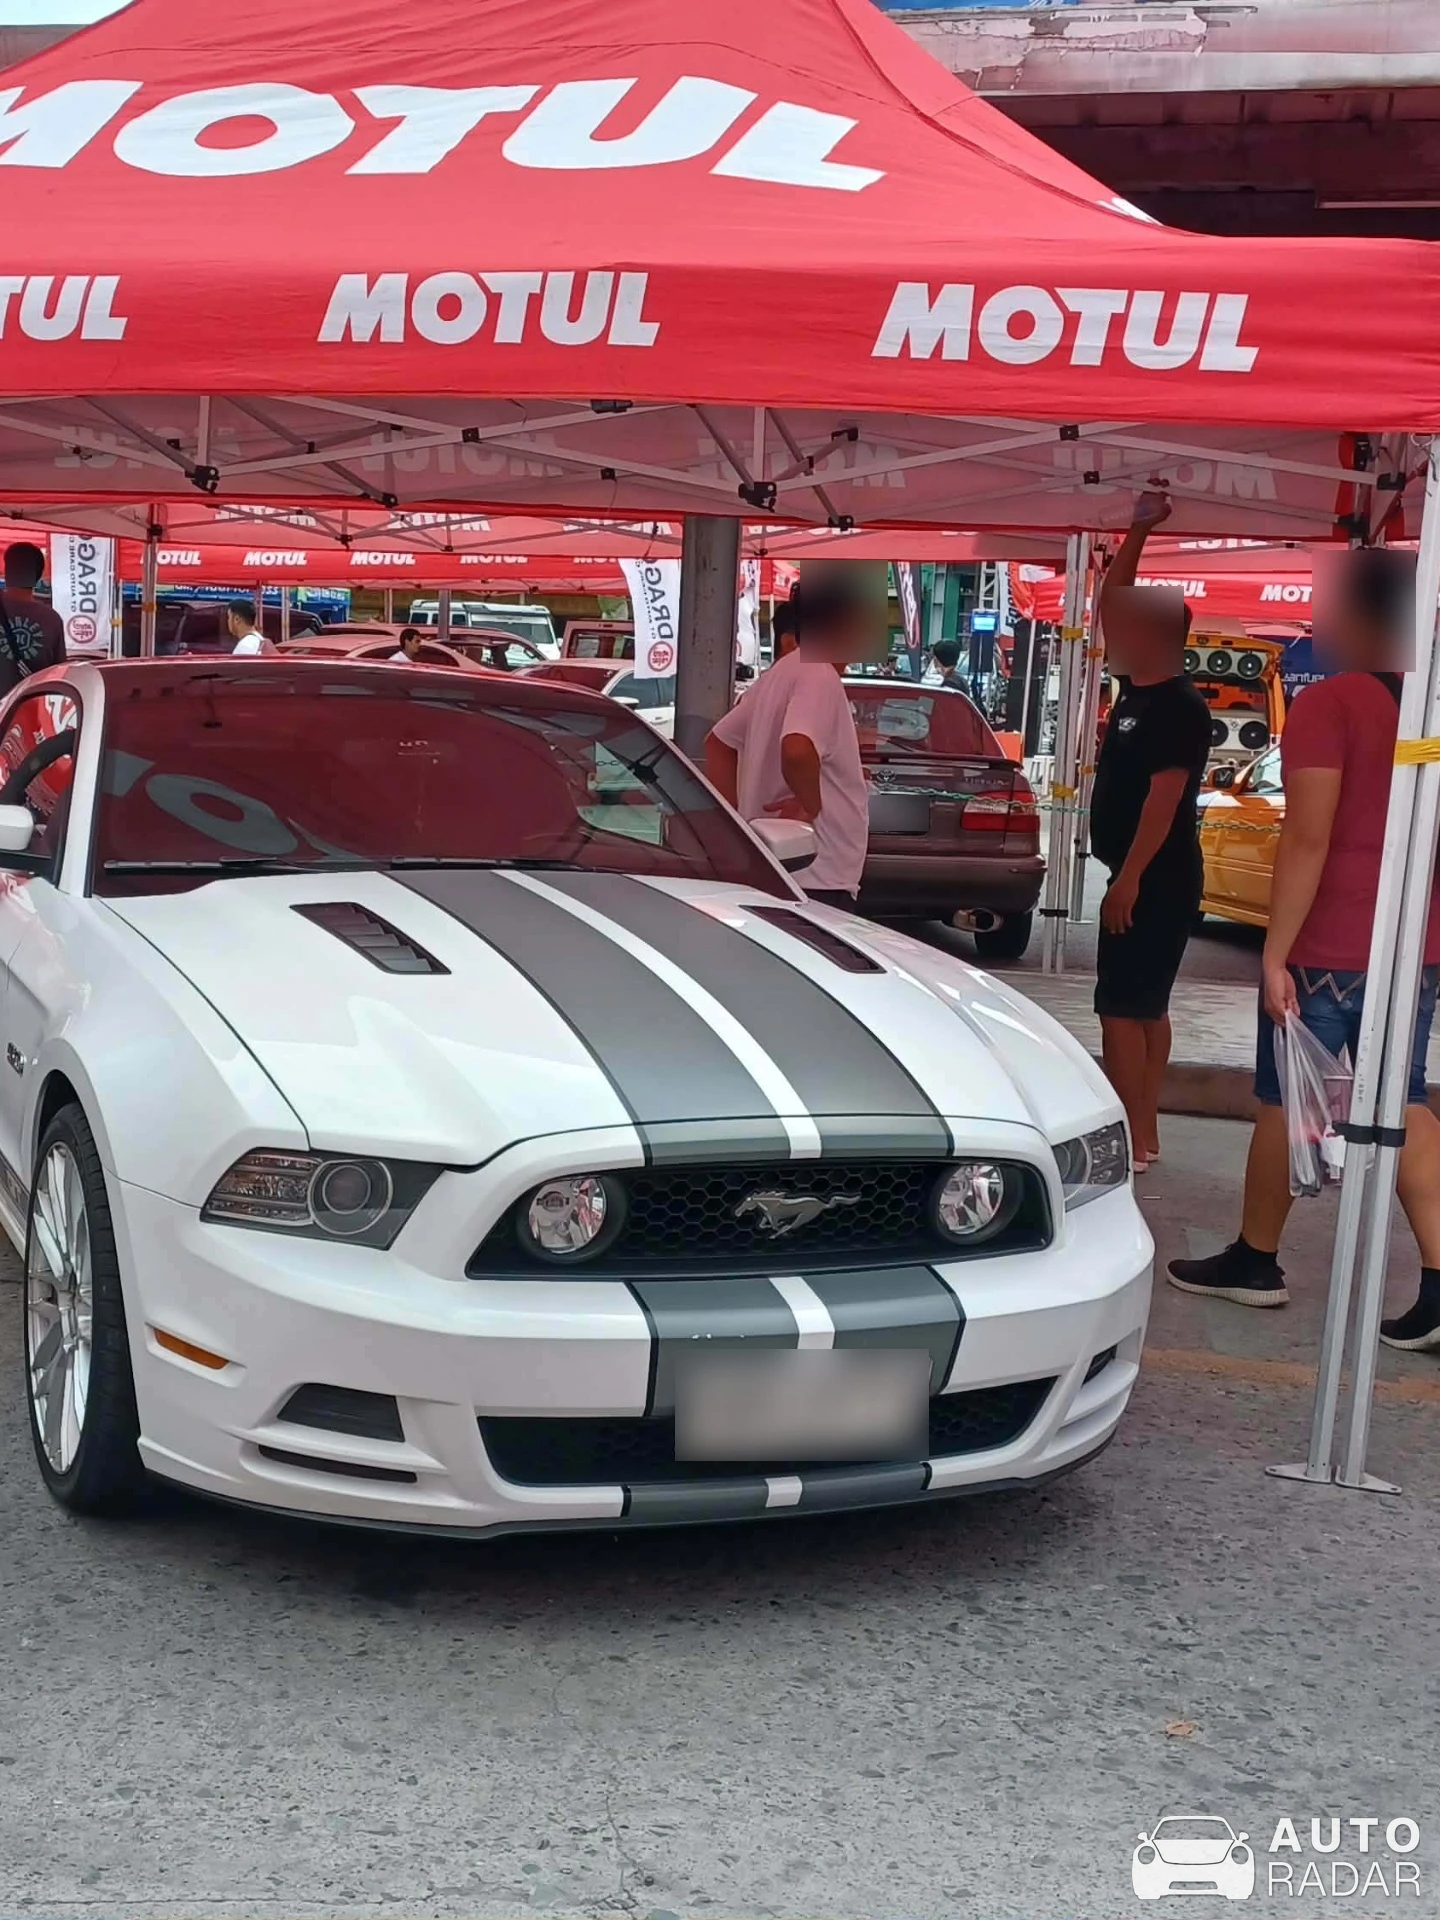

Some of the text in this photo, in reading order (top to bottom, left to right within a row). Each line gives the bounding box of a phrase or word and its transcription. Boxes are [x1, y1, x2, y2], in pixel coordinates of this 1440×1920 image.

[318, 272, 659, 346] MOTUL
[871, 282, 1259, 372] MOTUL
[141, 551, 201, 565] OTUL
[243, 552, 307, 566] MOTUL
[351, 552, 416, 566] MOTUL
[1259, 584, 1312, 602] MOT
